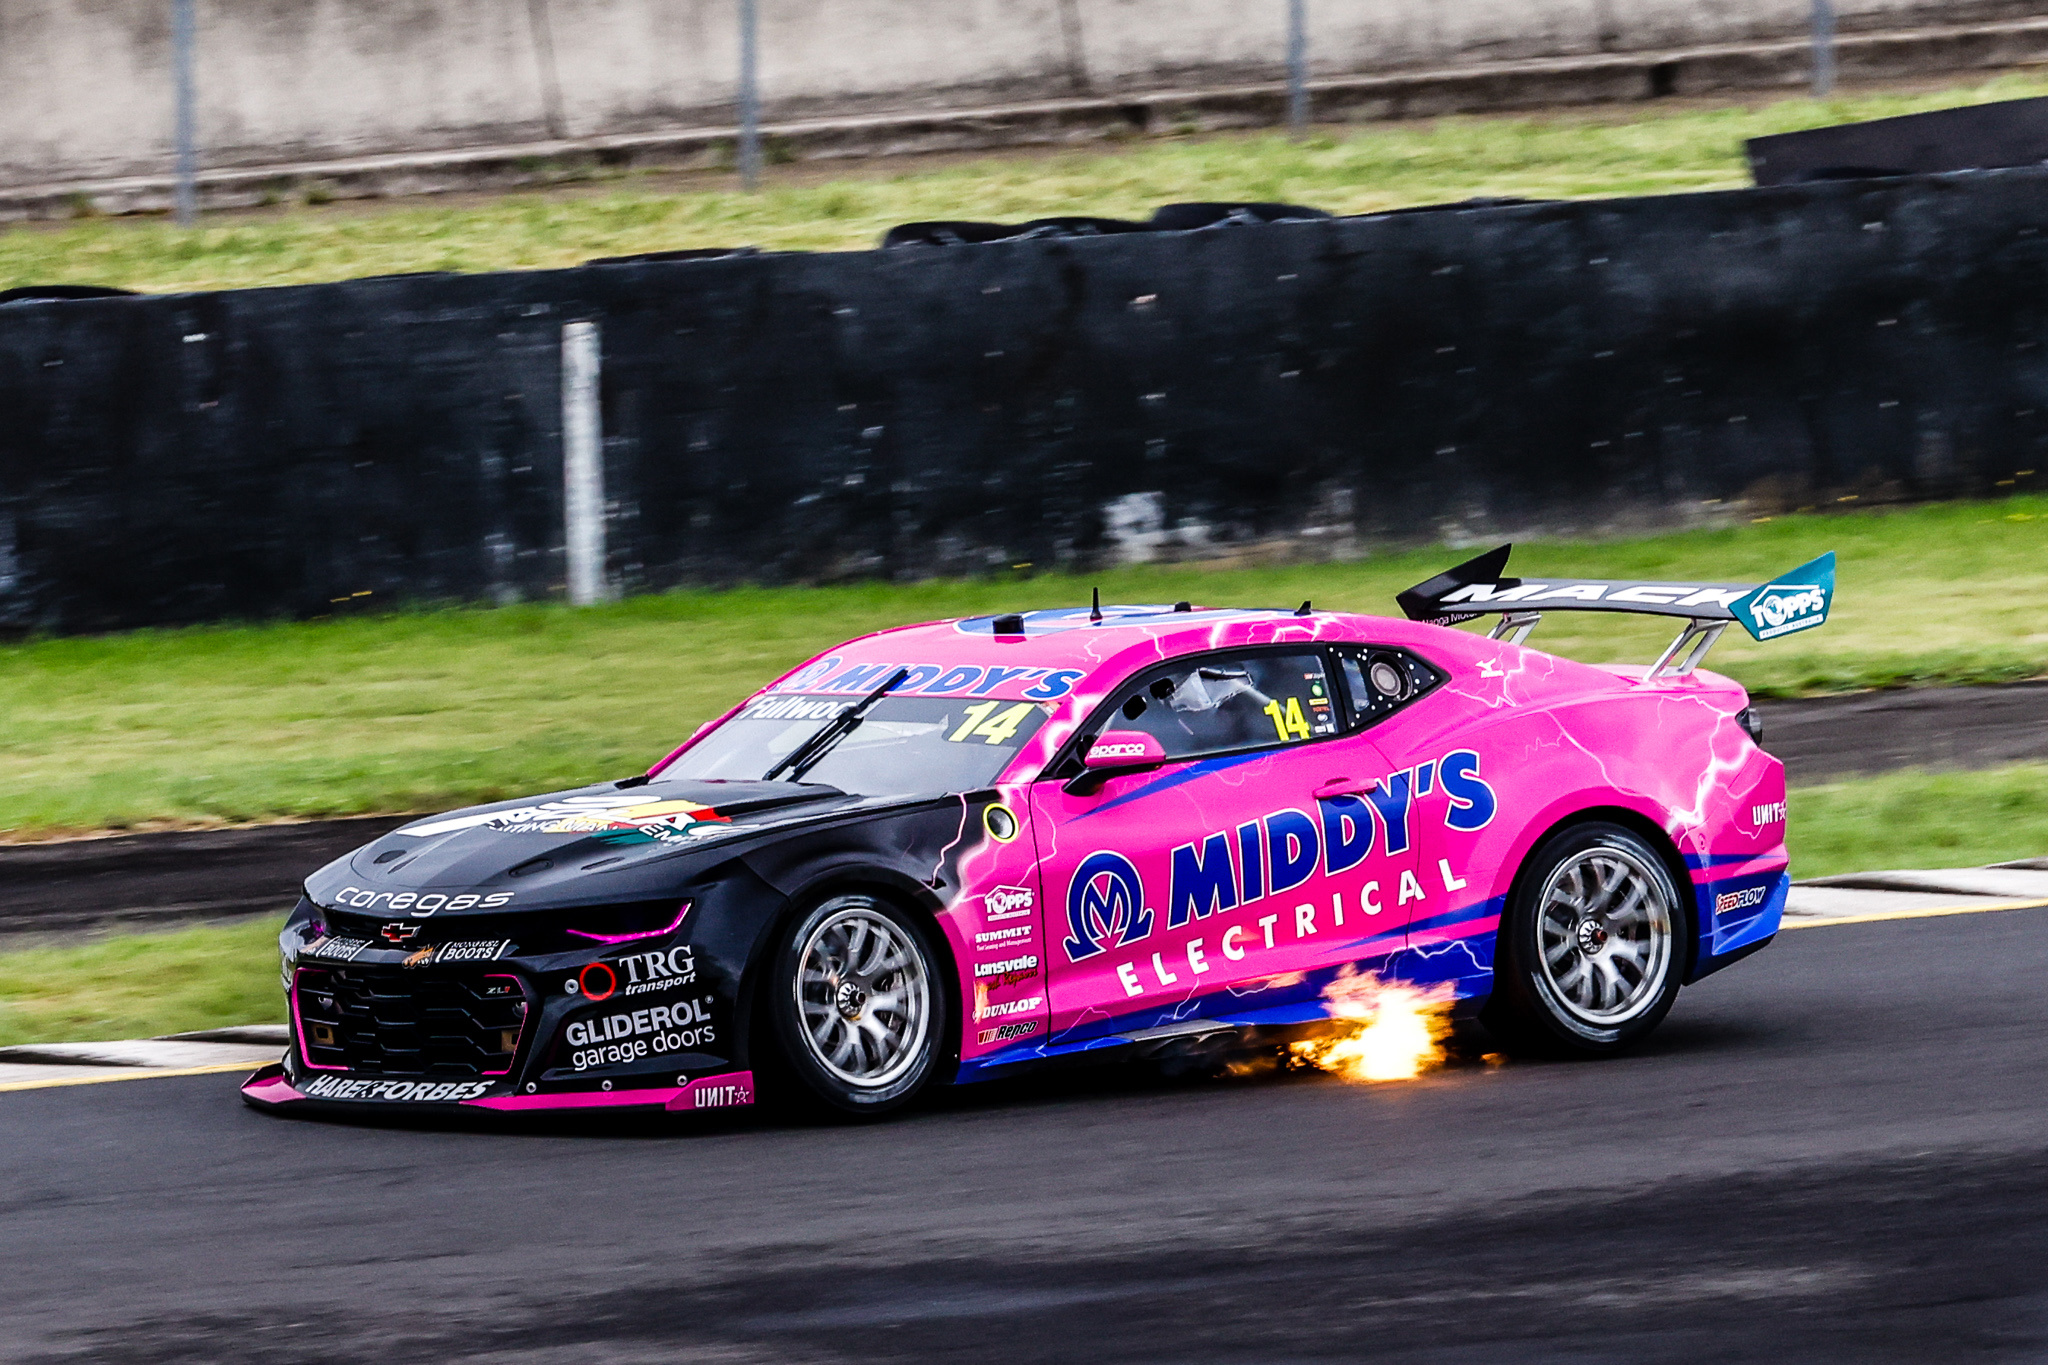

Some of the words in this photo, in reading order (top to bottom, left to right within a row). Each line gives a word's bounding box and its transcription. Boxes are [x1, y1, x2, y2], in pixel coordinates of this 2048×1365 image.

[1439, 583, 1753, 608] MACK
[1750, 589, 1824, 628] TOPPS
[812, 664, 1087, 700] MIDDY'S
[948, 700, 1036, 745] 14
[1263, 696, 1310, 741] 14
[1167, 749, 1497, 930] MIDDY'S
[335, 886, 515, 918] coregas
[975, 925, 1032, 943] SUMMIT
[1116, 858, 1467, 998] ELECTRICAL
[443, 947, 495, 960] BOOTS
[618, 945, 696, 984] TRG
[974, 954, 1039, 978] Lansvale
[625, 971, 697, 996] transport
[566, 998, 712, 1047] GLIDEROL
[982, 997, 1043, 1020] DUNLOP
[996, 1021, 1038, 1041] Repco
[572, 1038, 648, 1072] garage
[652, 1025, 716, 1053] doors
[694, 1085, 736, 1108] UNIT
